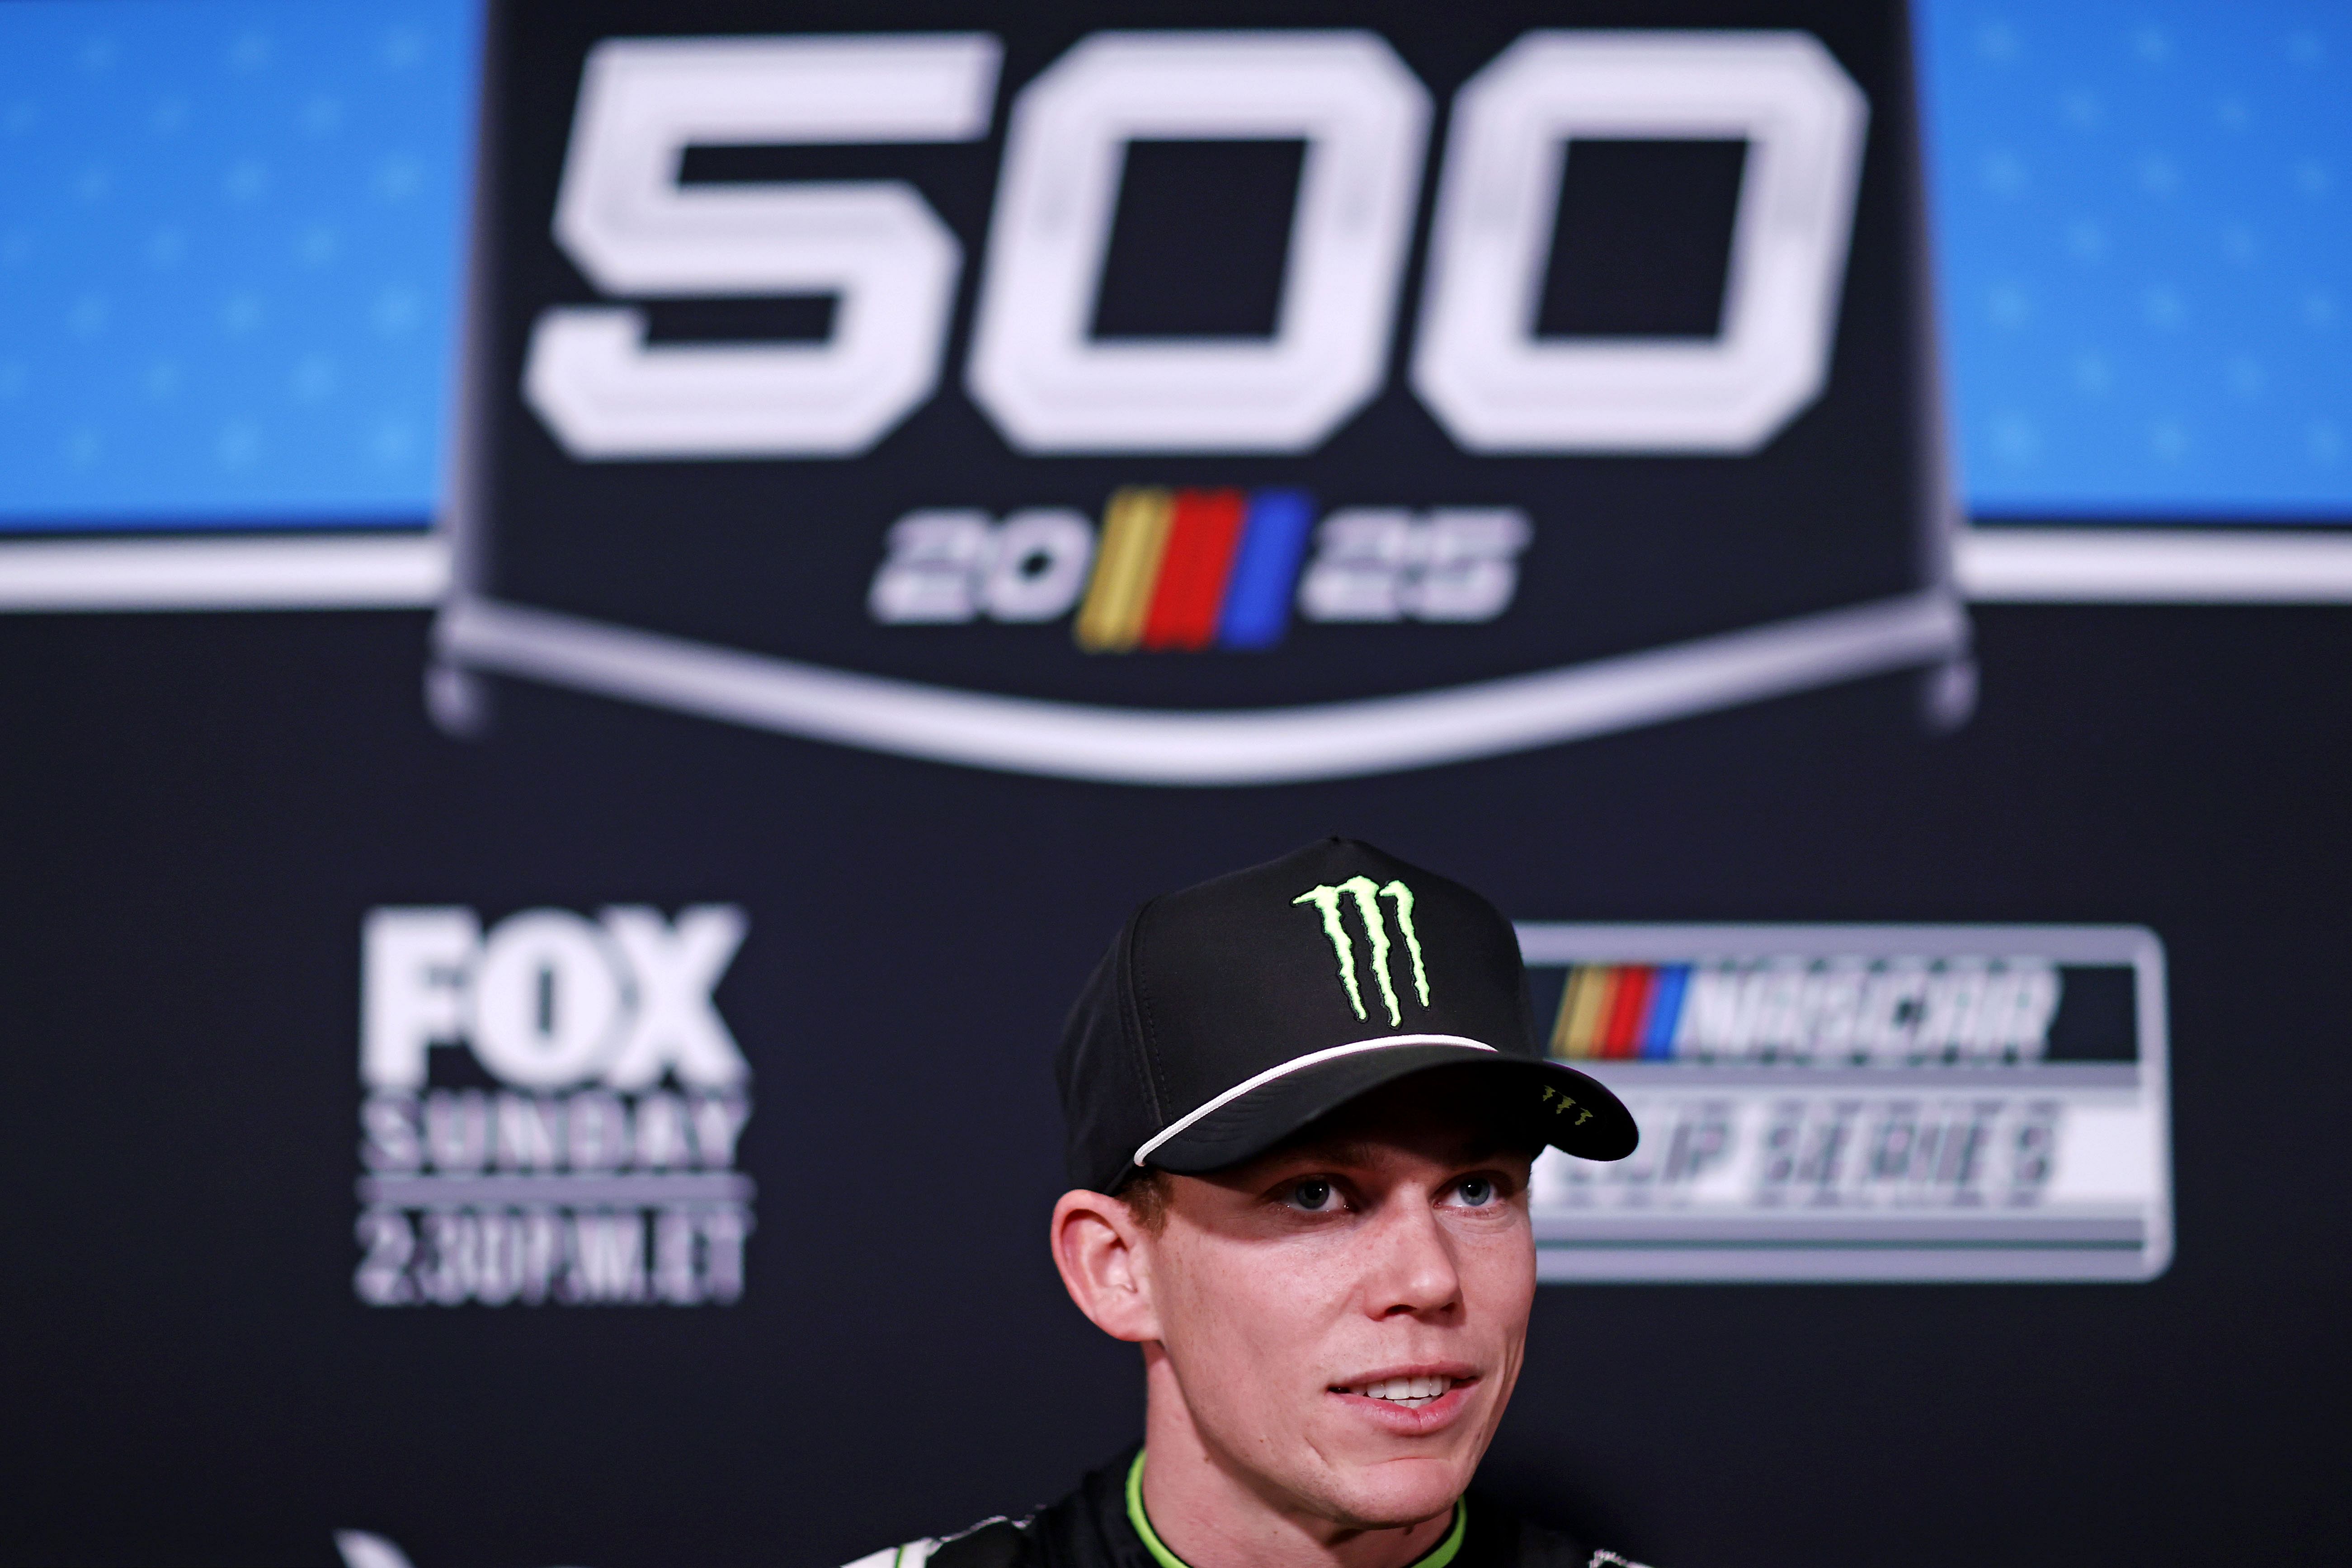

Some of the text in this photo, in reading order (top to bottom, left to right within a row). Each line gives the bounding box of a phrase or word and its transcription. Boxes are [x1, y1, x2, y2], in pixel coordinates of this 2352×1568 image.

[523, 30, 1870, 459] 500
[868, 506, 1532, 624] 20 25
[360, 904, 748, 1088] FOX
[1673, 956, 2061, 1063] NASCAR
[361, 1090, 749, 1170] SUNDAY
[1755, 1098, 2060, 1206] SERIES
